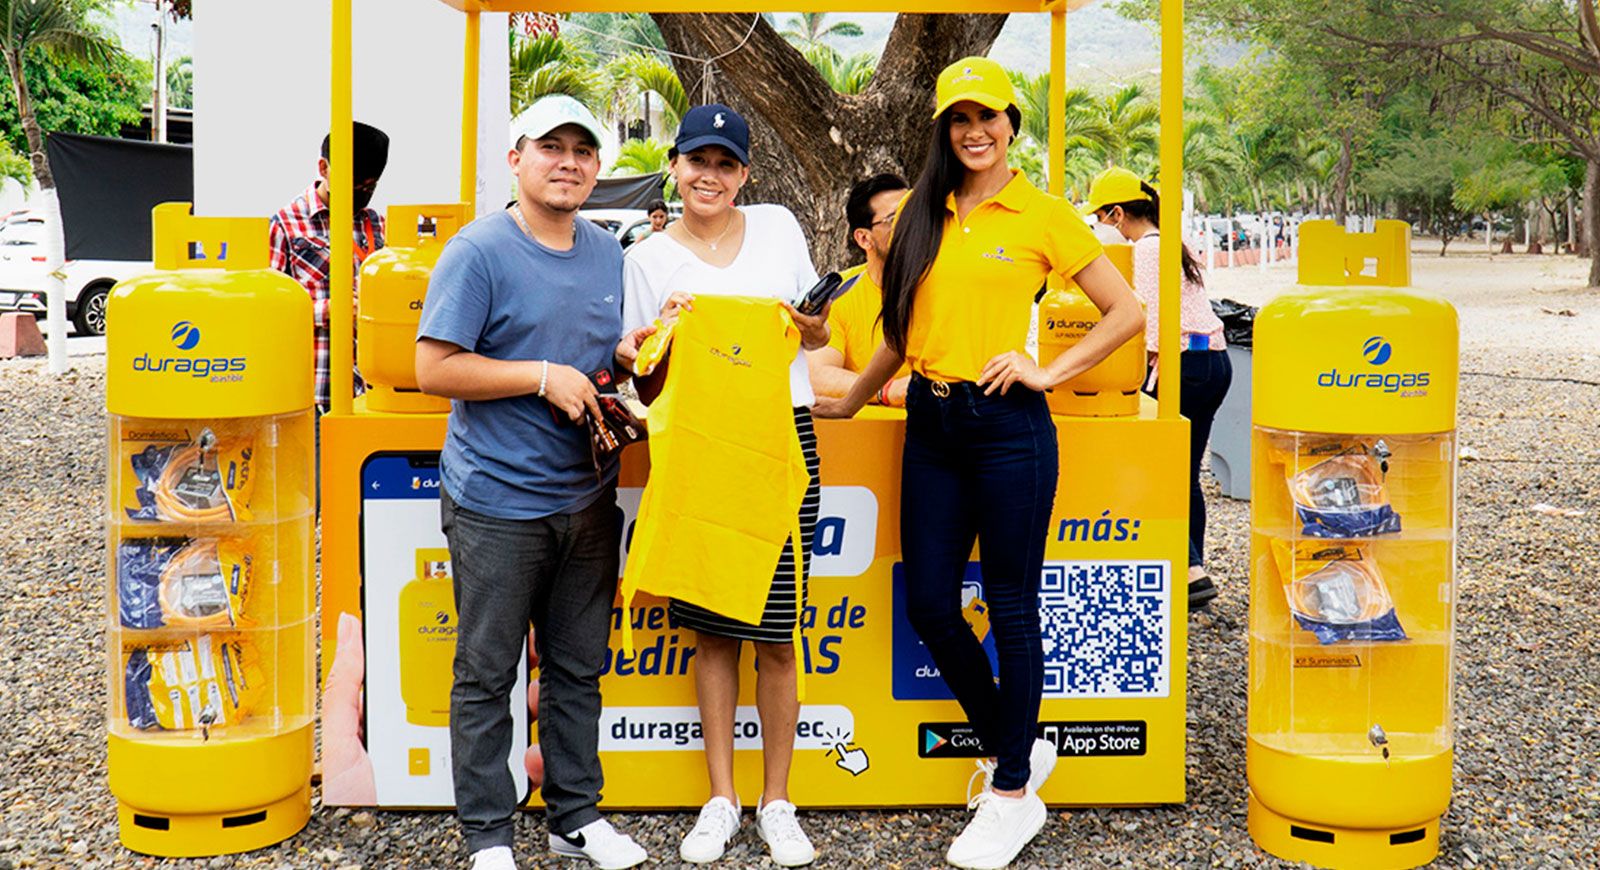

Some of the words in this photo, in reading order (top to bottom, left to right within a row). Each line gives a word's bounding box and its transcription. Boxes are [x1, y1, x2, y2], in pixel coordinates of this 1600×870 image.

[133, 352, 247, 377] duragas
[1317, 368, 1430, 393] duragas
[1057, 509, 1141, 542] más:
[827, 596, 866, 629] de
[418, 625, 458, 635] duraga
[611, 716, 824, 745] duragacoec
[1063, 735, 1097, 754] App
[1099, 734, 1140, 750] Store
